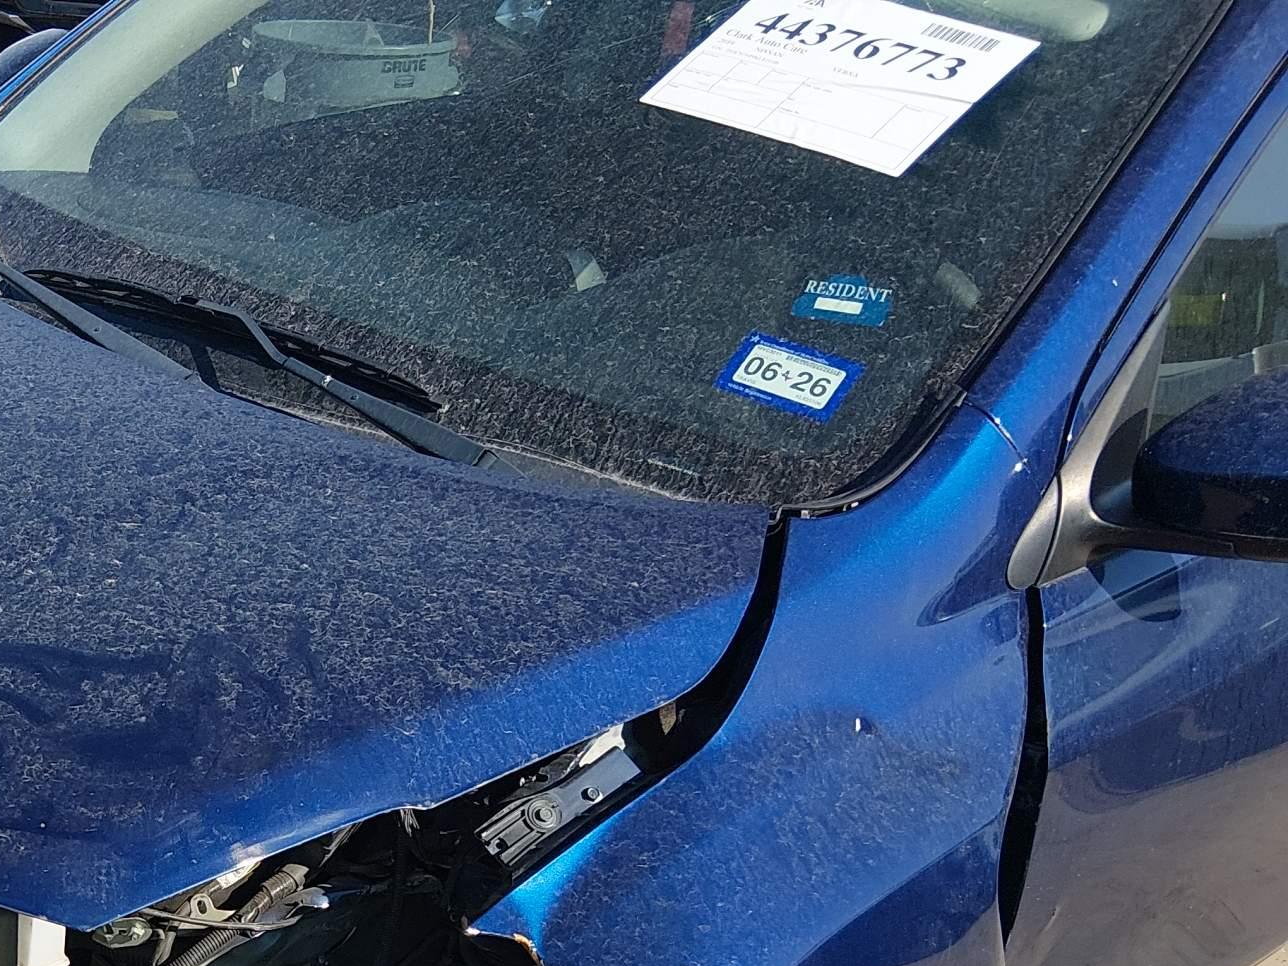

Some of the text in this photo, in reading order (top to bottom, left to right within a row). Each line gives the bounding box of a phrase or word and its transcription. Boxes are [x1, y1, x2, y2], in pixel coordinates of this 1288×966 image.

[725, 28, 753, 41] Clark
[755, 36, 782, 48] Auto
[754, 12, 967, 82] 44376773
[803, 279, 893, 303] RESIDENT
[743, 356, 784, 382] 06
[789, 370, 832, 398] 26
